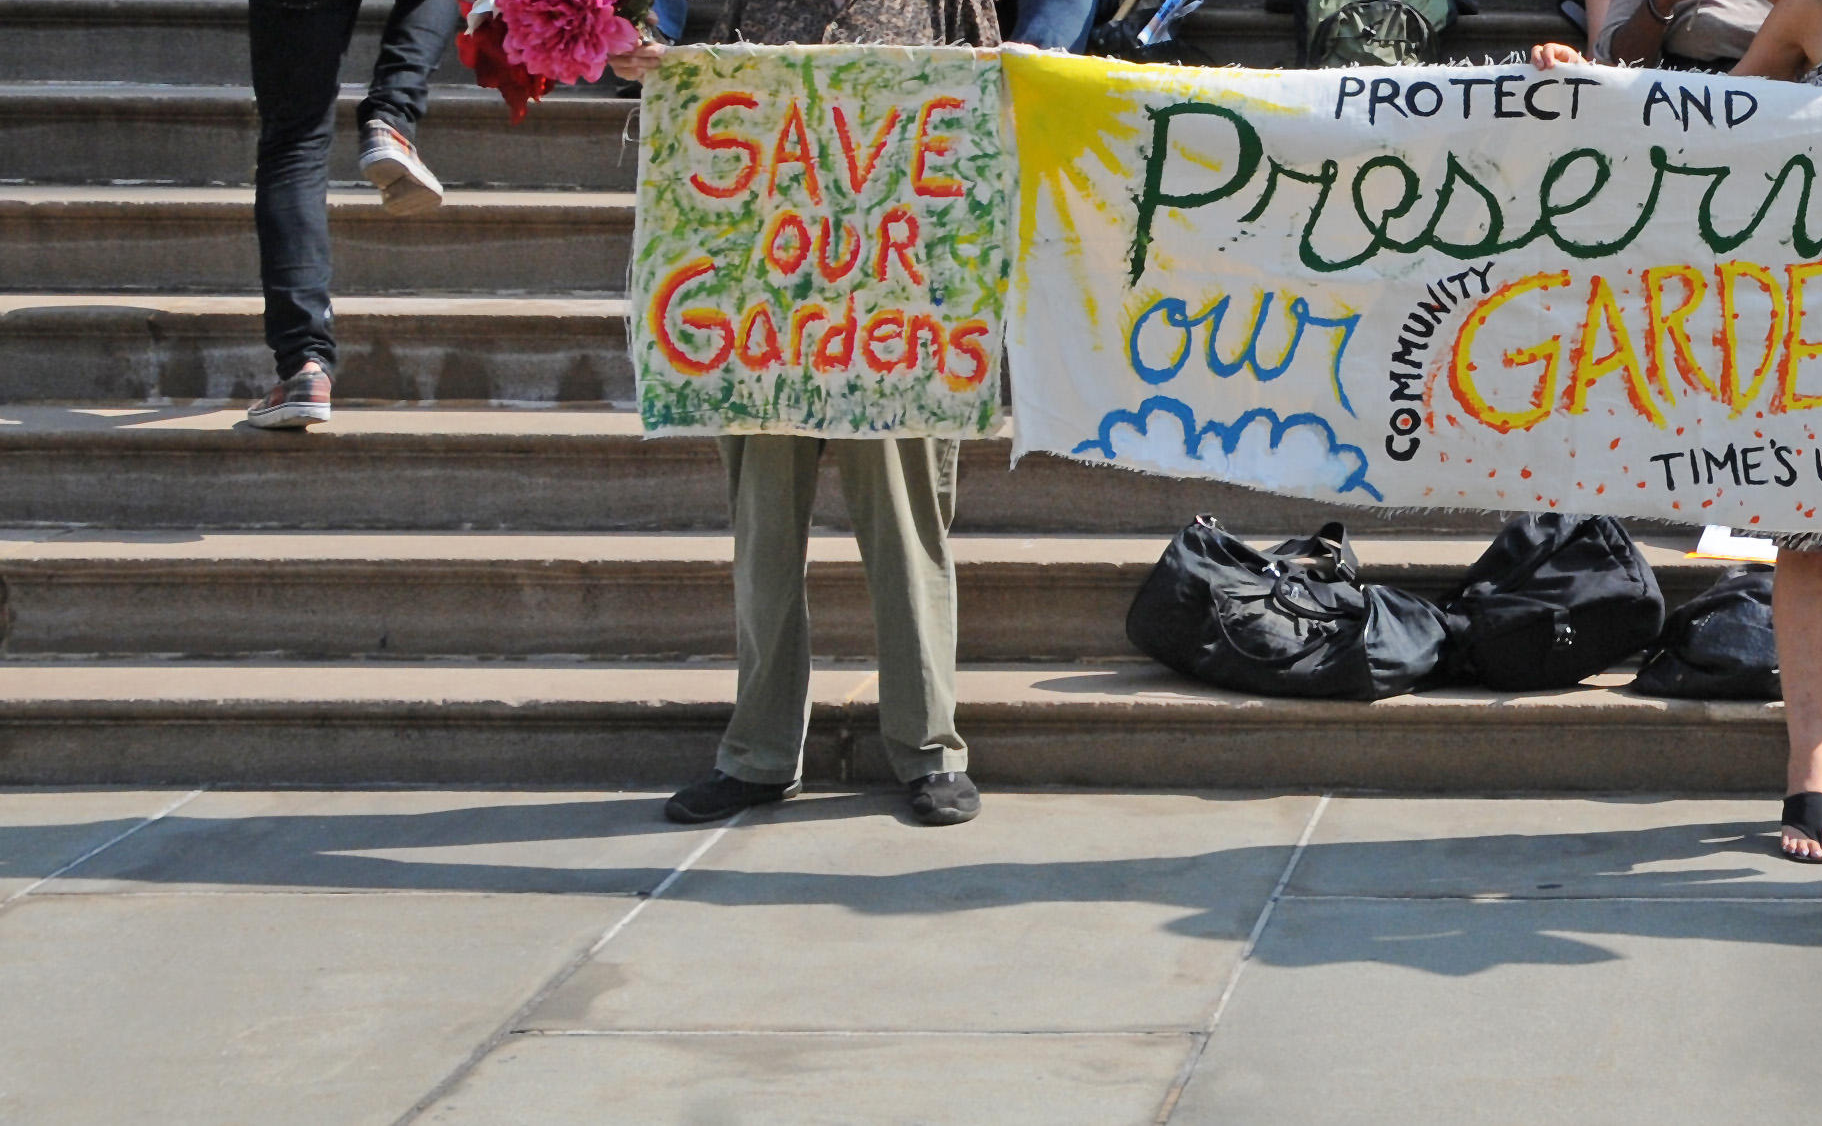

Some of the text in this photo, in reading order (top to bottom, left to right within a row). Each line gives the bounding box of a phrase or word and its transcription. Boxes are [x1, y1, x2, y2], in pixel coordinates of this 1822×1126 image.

[690, 91, 965, 205] SAVE
[1334, 76, 1760, 130] PROTECT AND
[765, 206, 924, 286] OUR
[648, 256, 990, 392] Gardens
[1130, 291, 1360, 419] our
[1385, 260, 1495, 462] COMMUNITY
[1650, 439, 1798, 491] TIME'S
